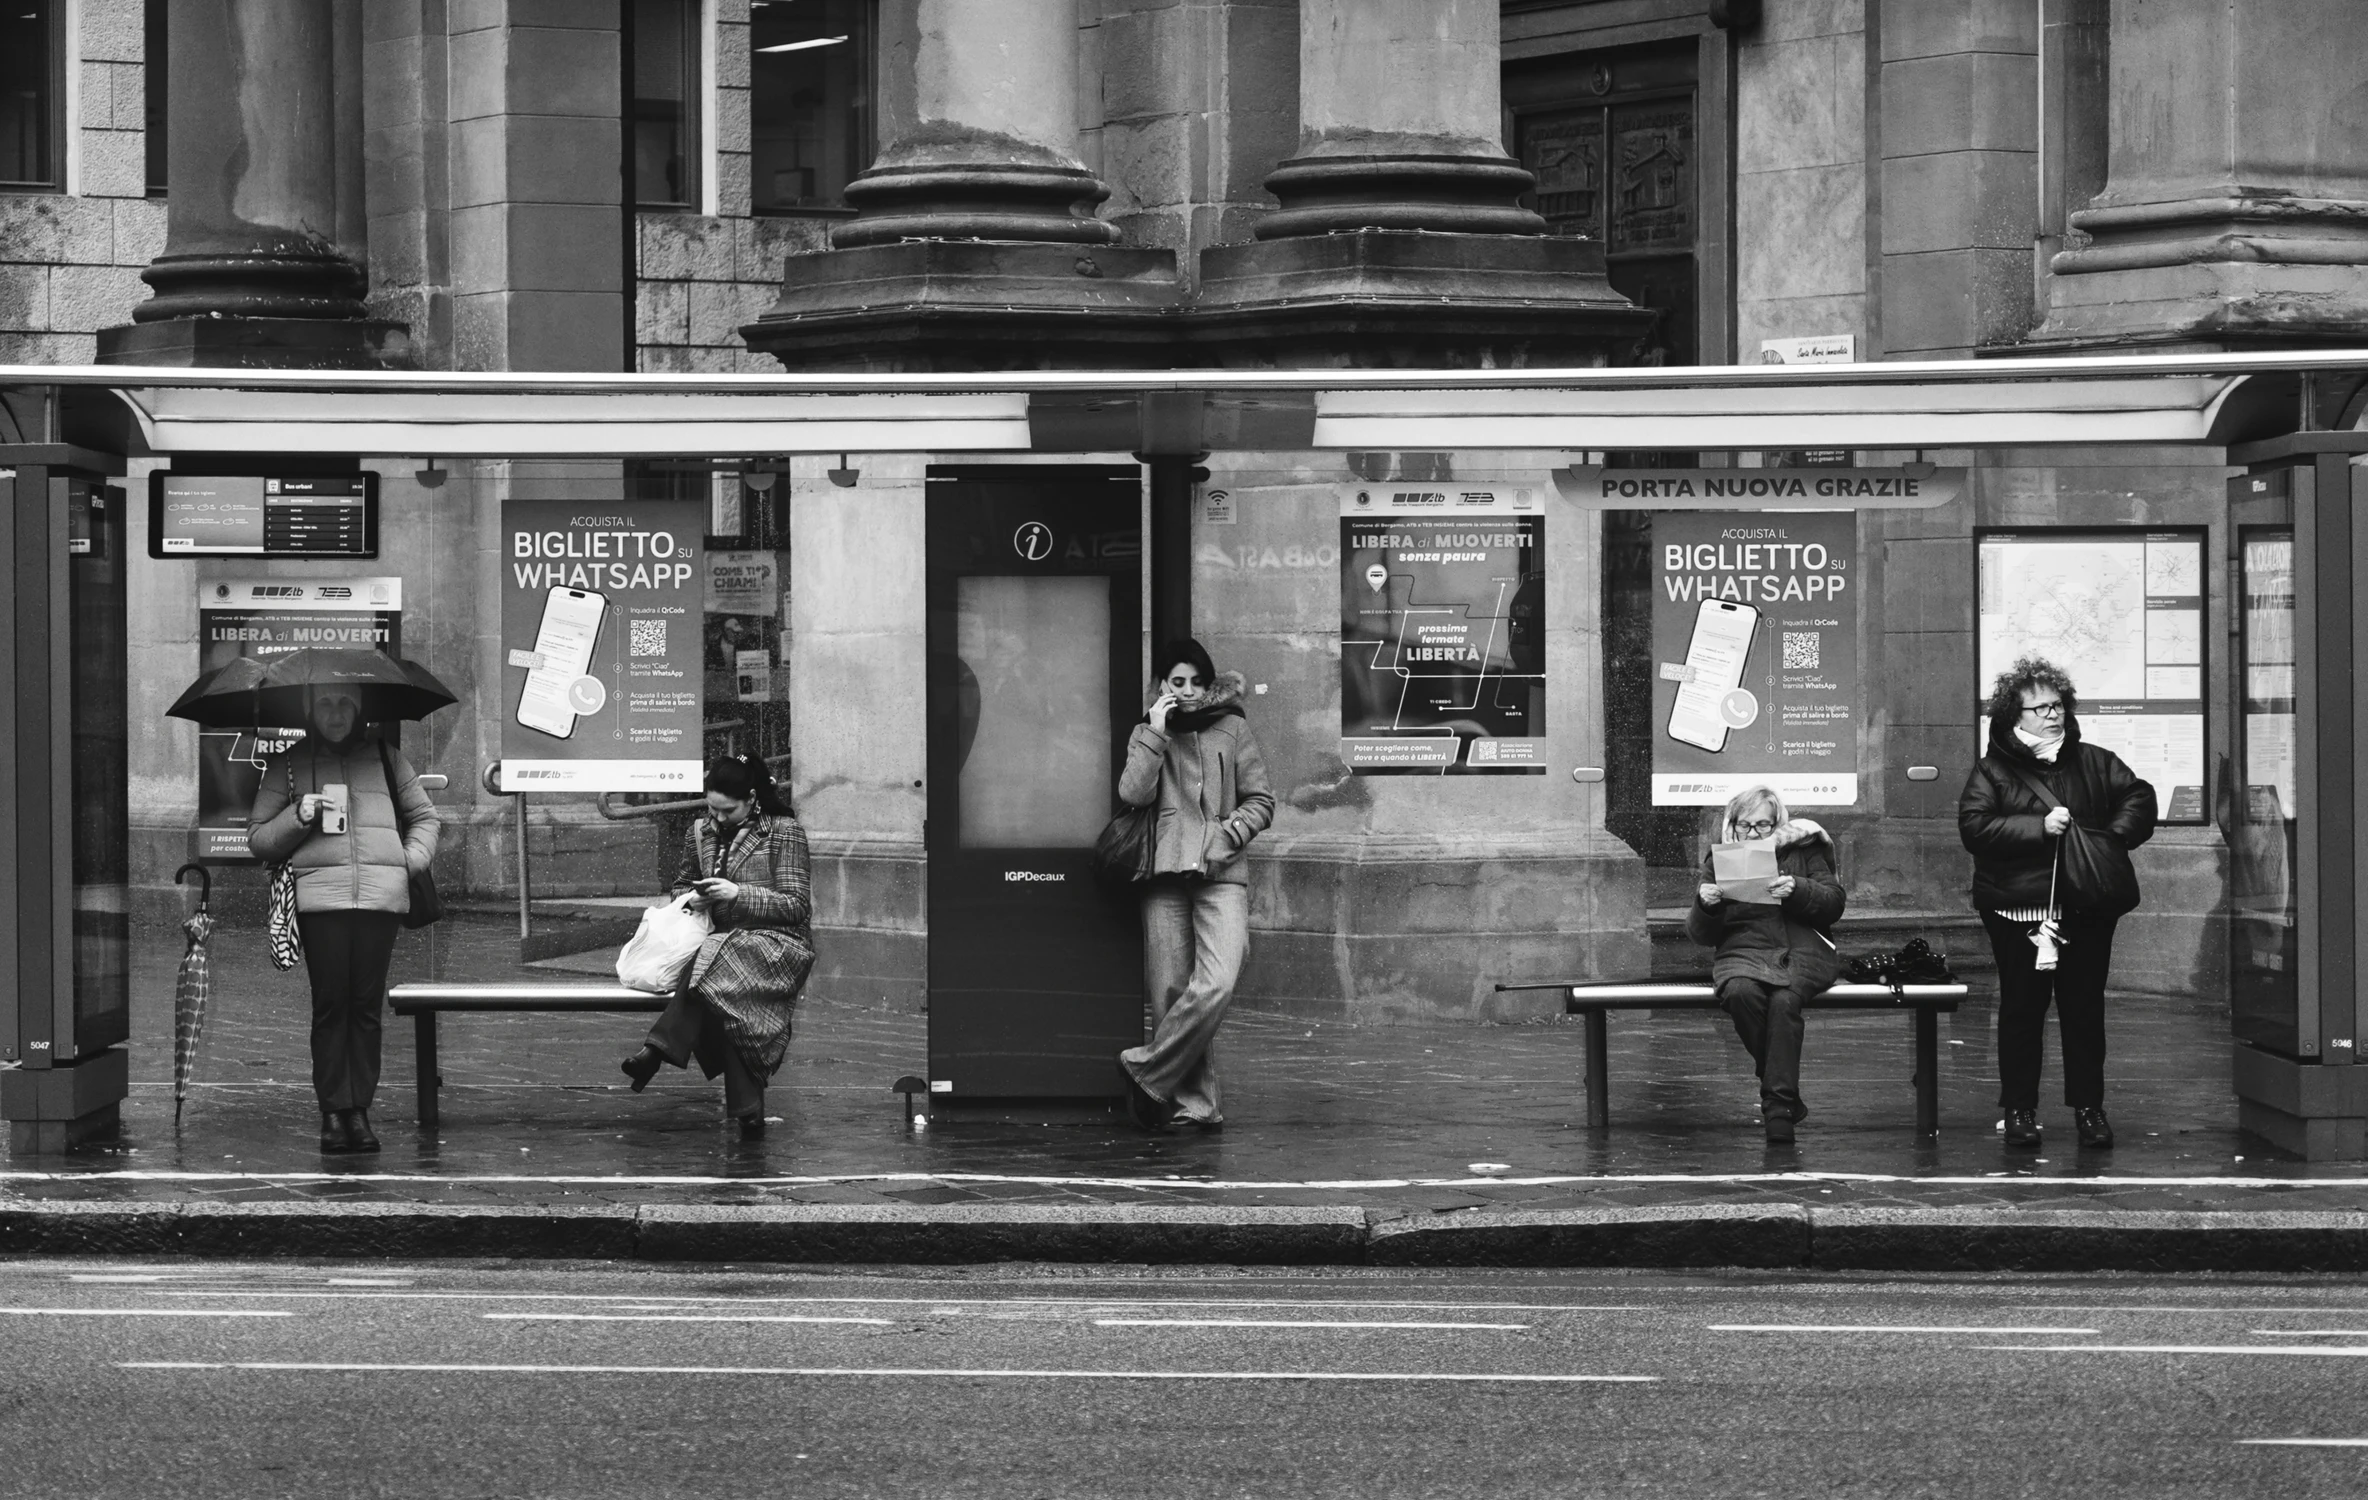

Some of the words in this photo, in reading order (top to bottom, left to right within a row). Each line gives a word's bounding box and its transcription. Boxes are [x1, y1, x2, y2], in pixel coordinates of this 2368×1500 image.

[1602, 479, 1696, 498] PORTA
[1704, 479, 1808, 497] NUOVA
[1815, 478, 1919, 497] GRAZIE
[570, 517, 624, 527] ACQUISTA
[627, 517, 636, 526] IL
[1722, 528, 1776, 540] ACQUISTA
[1779, 528, 1788, 539] IL
[514, 532, 674, 558] BIGLIETTO
[678, 548, 693, 558] SU
[1352, 535, 1414, 548] LIBERA
[1418, 537, 1430, 548] di
[1435, 534, 1533, 548] MUOVERTI
[1399, 553, 1440, 562] senza
[1442, 552, 1486, 564] paura
[1665, 543, 1827, 570] BIGLIETTO
[1831, 559, 1846, 570] SU
[513, 563, 692, 589] WHATSAPP
[713, 567, 743, 576] COME
[746, 567, 755, 576] TI
[1664, 575, 1846, 602] WHATSAPP
[212, 628, 272, 641] LIBERA
[276, 630, 288, 641] di
[293, 628, 389, 642] MUOVERTI
[1418, 625, 1468, 635] prossima
[1422, 635, 1464, 644] fermata
[1407, 644, 1480, 661] LIBERTÀ
[1375, 745, 1408, 753] scegliere
[1005, 872, 1065, 881] IGPDecaux
[30, 1041, 50, 1050] 5047
[2332, 1039, 2352, 1048] 5046
